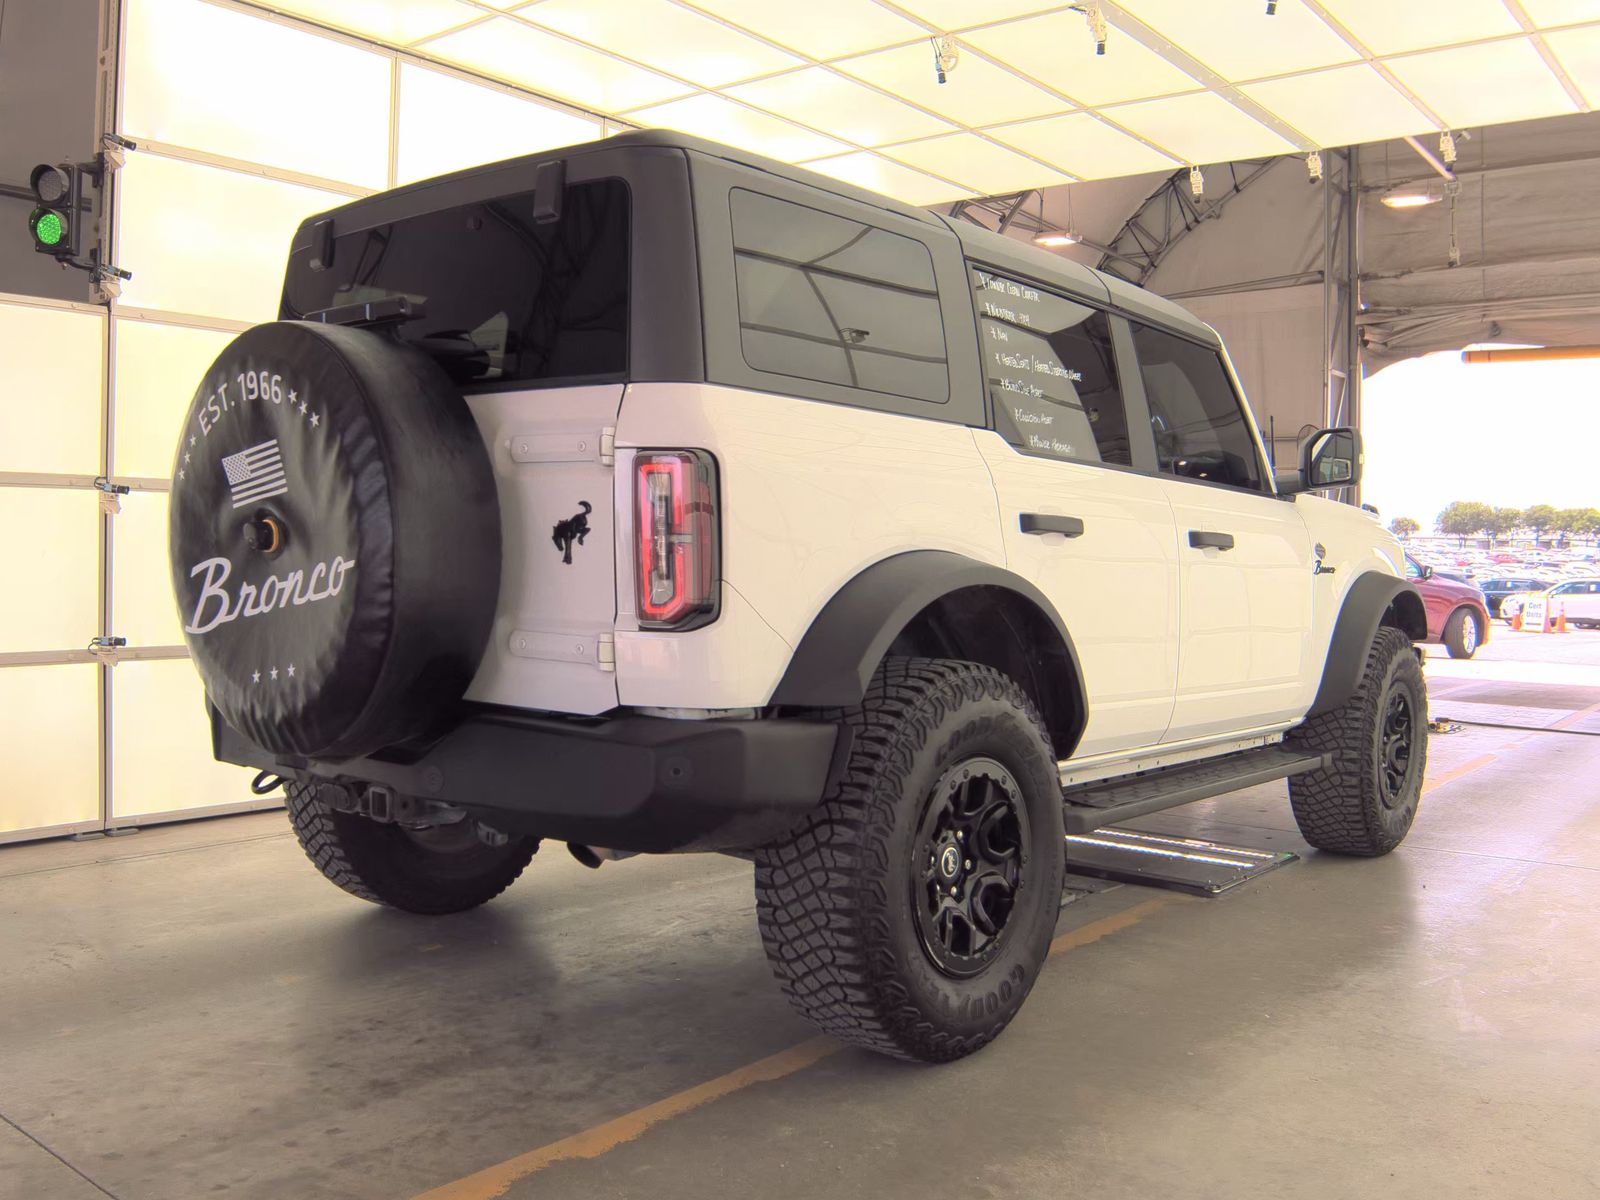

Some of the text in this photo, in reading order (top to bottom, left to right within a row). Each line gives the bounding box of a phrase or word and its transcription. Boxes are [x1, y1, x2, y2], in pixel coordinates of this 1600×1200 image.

[198, 370, 282, 437] EST. 1966
[185, 556, 355, 634] Bronco
